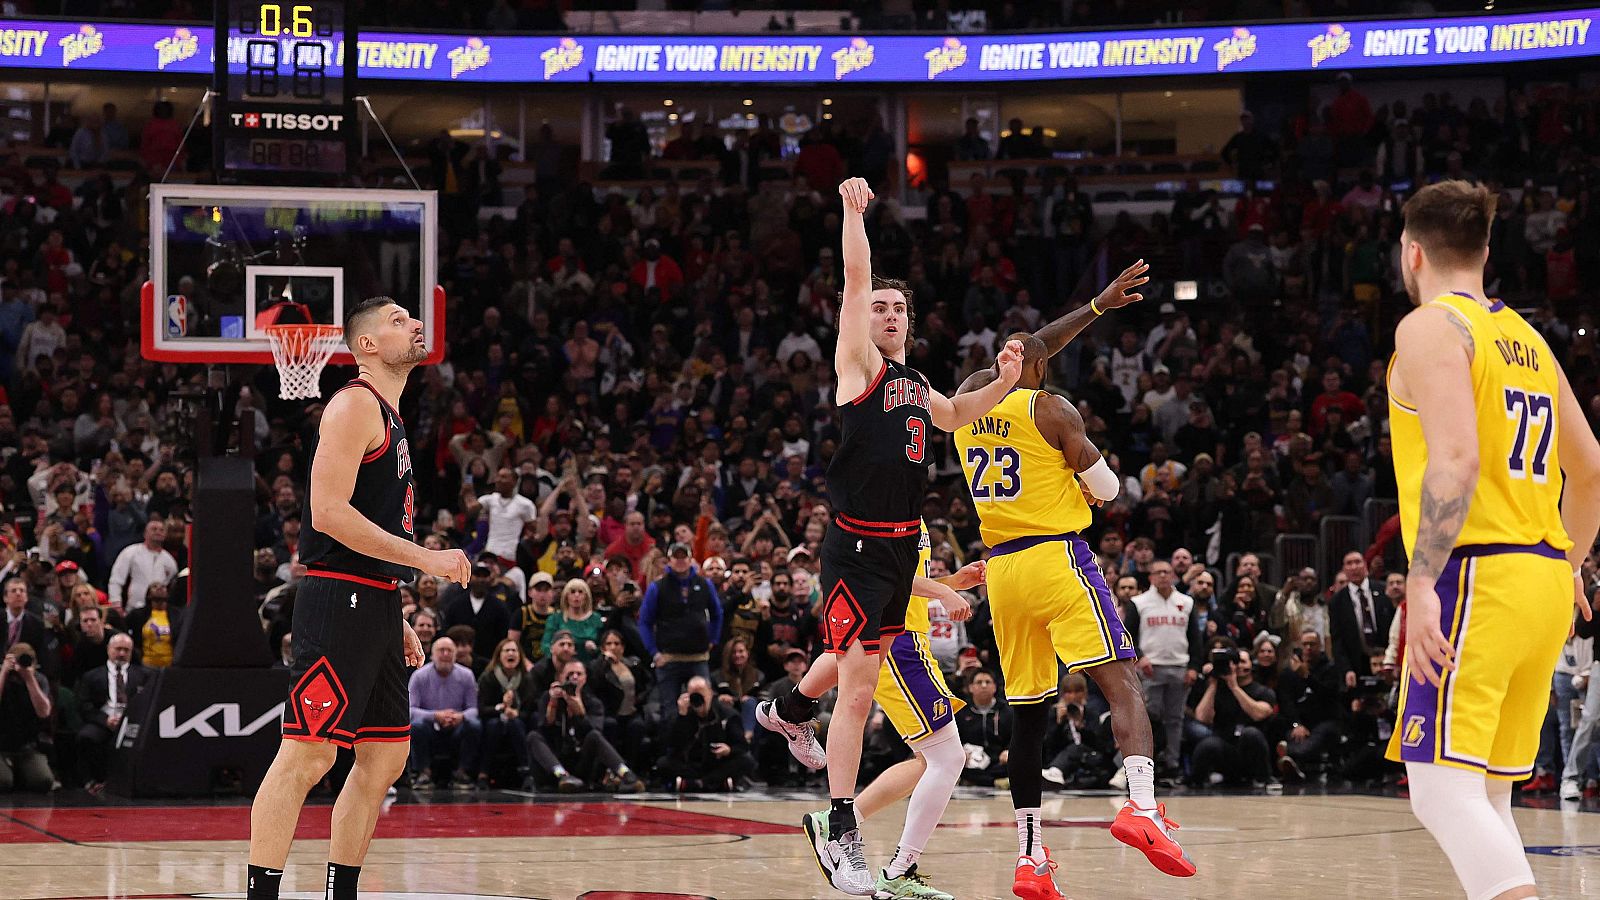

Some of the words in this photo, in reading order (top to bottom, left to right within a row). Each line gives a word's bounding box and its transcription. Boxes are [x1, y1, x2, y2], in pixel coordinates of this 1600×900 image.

[260, 4, 313, 37] 0.6
[1363, 27, 1431, 56] IGNITE
[1433, 25, 1488, 53] YOUR
[1490, 18, 1591, 51] INTENSITY
[335, 41, 438, 69] ITENSITY
[595, 45, 663, 72] IGNITE
[664, 45, 718, 72] YOUR
[719, 45, 823, 72] INTENSITY
[979, 43, 1047, 71] IGNITE
[1048, 41, 1101, 69] YOUR
[1102, 37, 1204, 67] INTENSITY
[261, 113, 343, 131] TISSOT
[905, 416, 925, 464] 3
[971, 416, 1011, 438] JAMES
[1504, 386, 1556, 484] 77
[966, 446, 1021, 503] 23
[402, 481, 414, 535] 9
